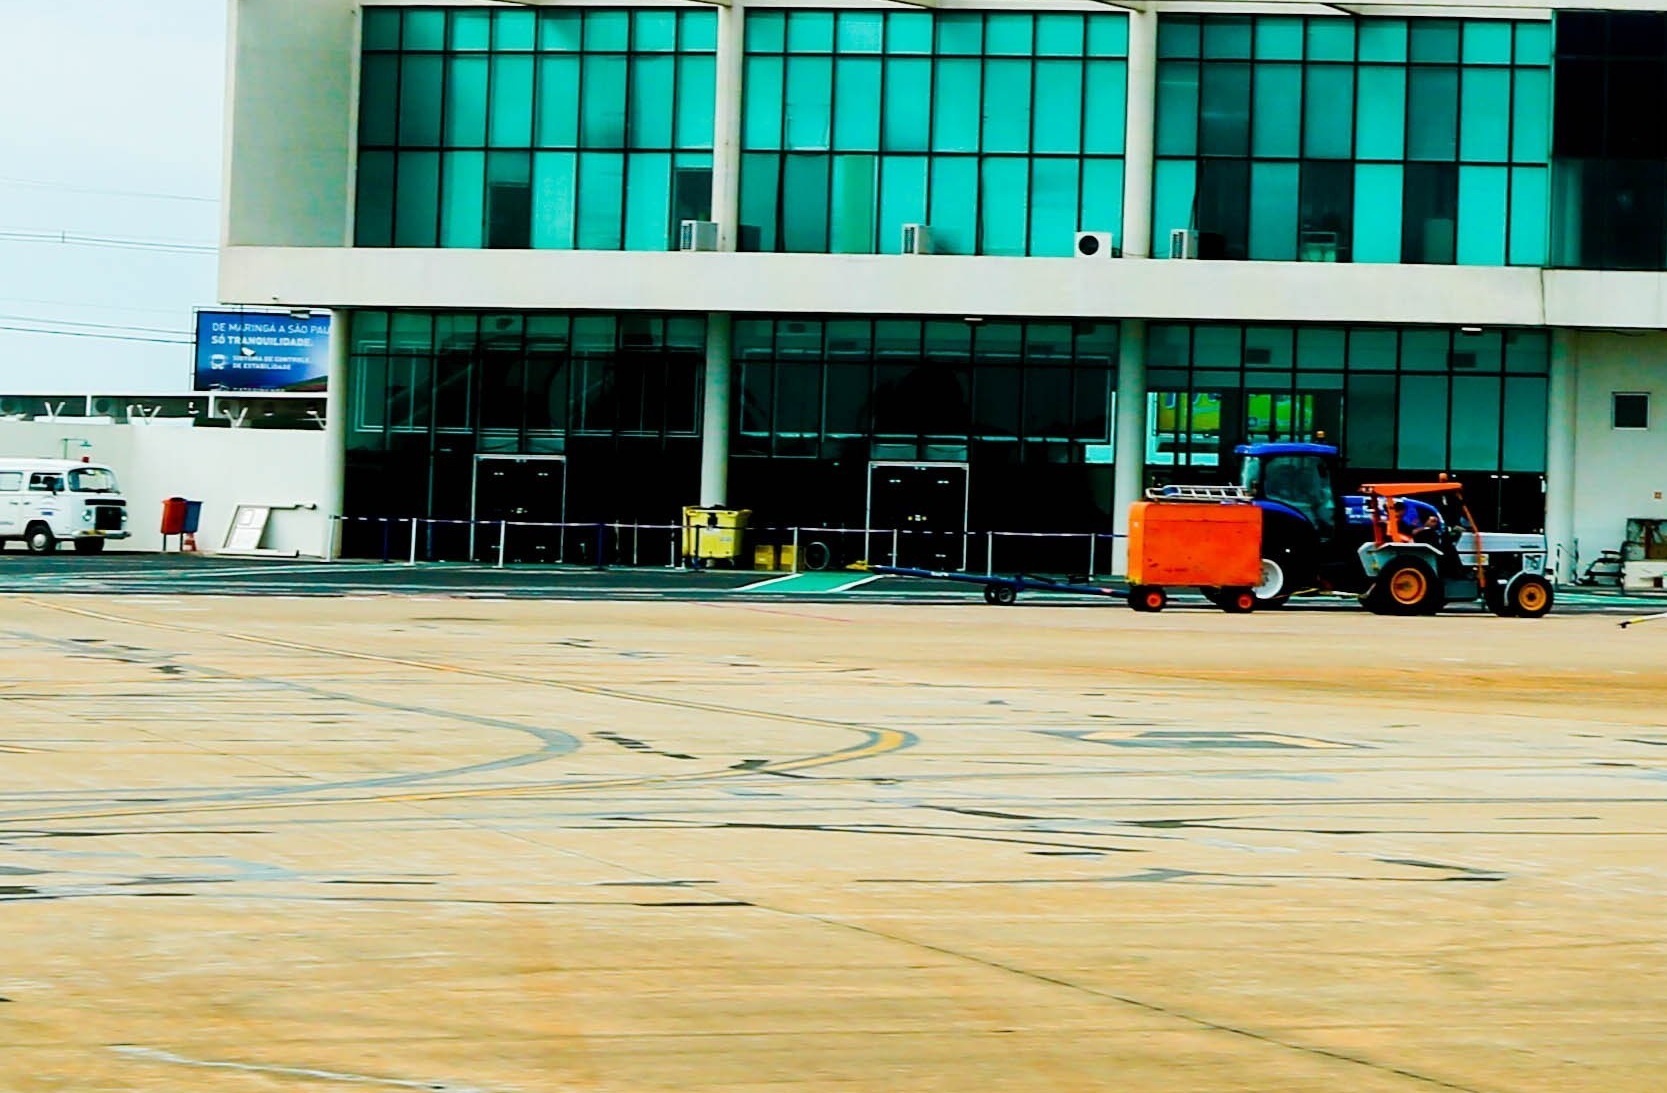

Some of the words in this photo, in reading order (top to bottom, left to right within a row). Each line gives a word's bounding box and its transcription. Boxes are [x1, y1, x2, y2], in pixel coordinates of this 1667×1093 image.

[212, 322, 226, 332] DE
[229, 322, 276, 333] MARINGÁ
[278, 324, 285, 333] A
[287, 322, 308, 334] SÃO
[211, 333, 226, 344] SÓ
